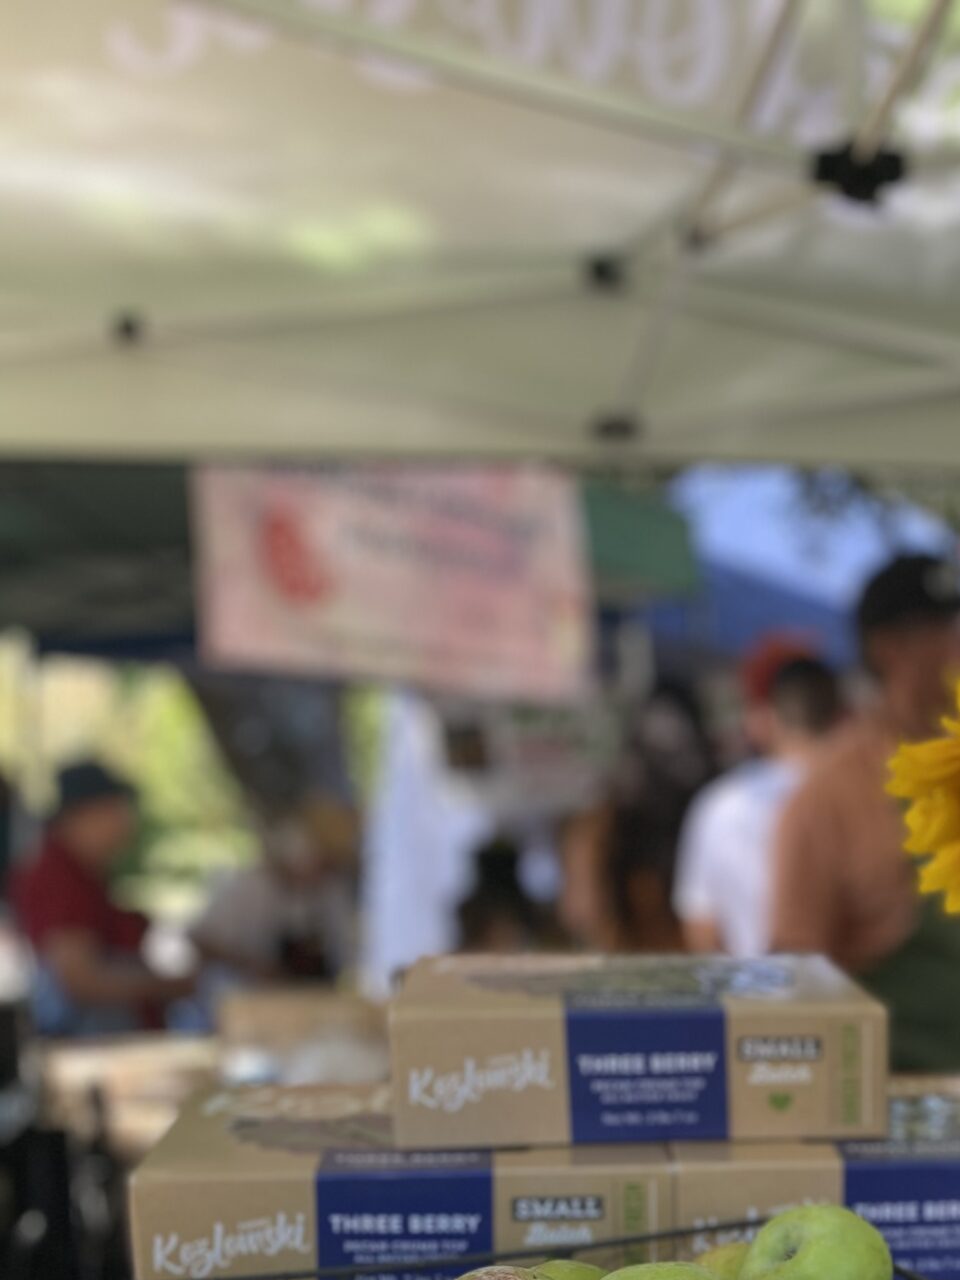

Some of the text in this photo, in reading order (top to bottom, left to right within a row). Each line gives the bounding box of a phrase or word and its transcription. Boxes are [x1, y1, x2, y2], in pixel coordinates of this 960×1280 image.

[576, 1051, 717, 1075] THREE BERRY
[515, 1199, 599, 1218] SMALL
[329, 1213, 481, 1234] THREE BERRY
[153, 1211, 312, 1279] Kozlowski
